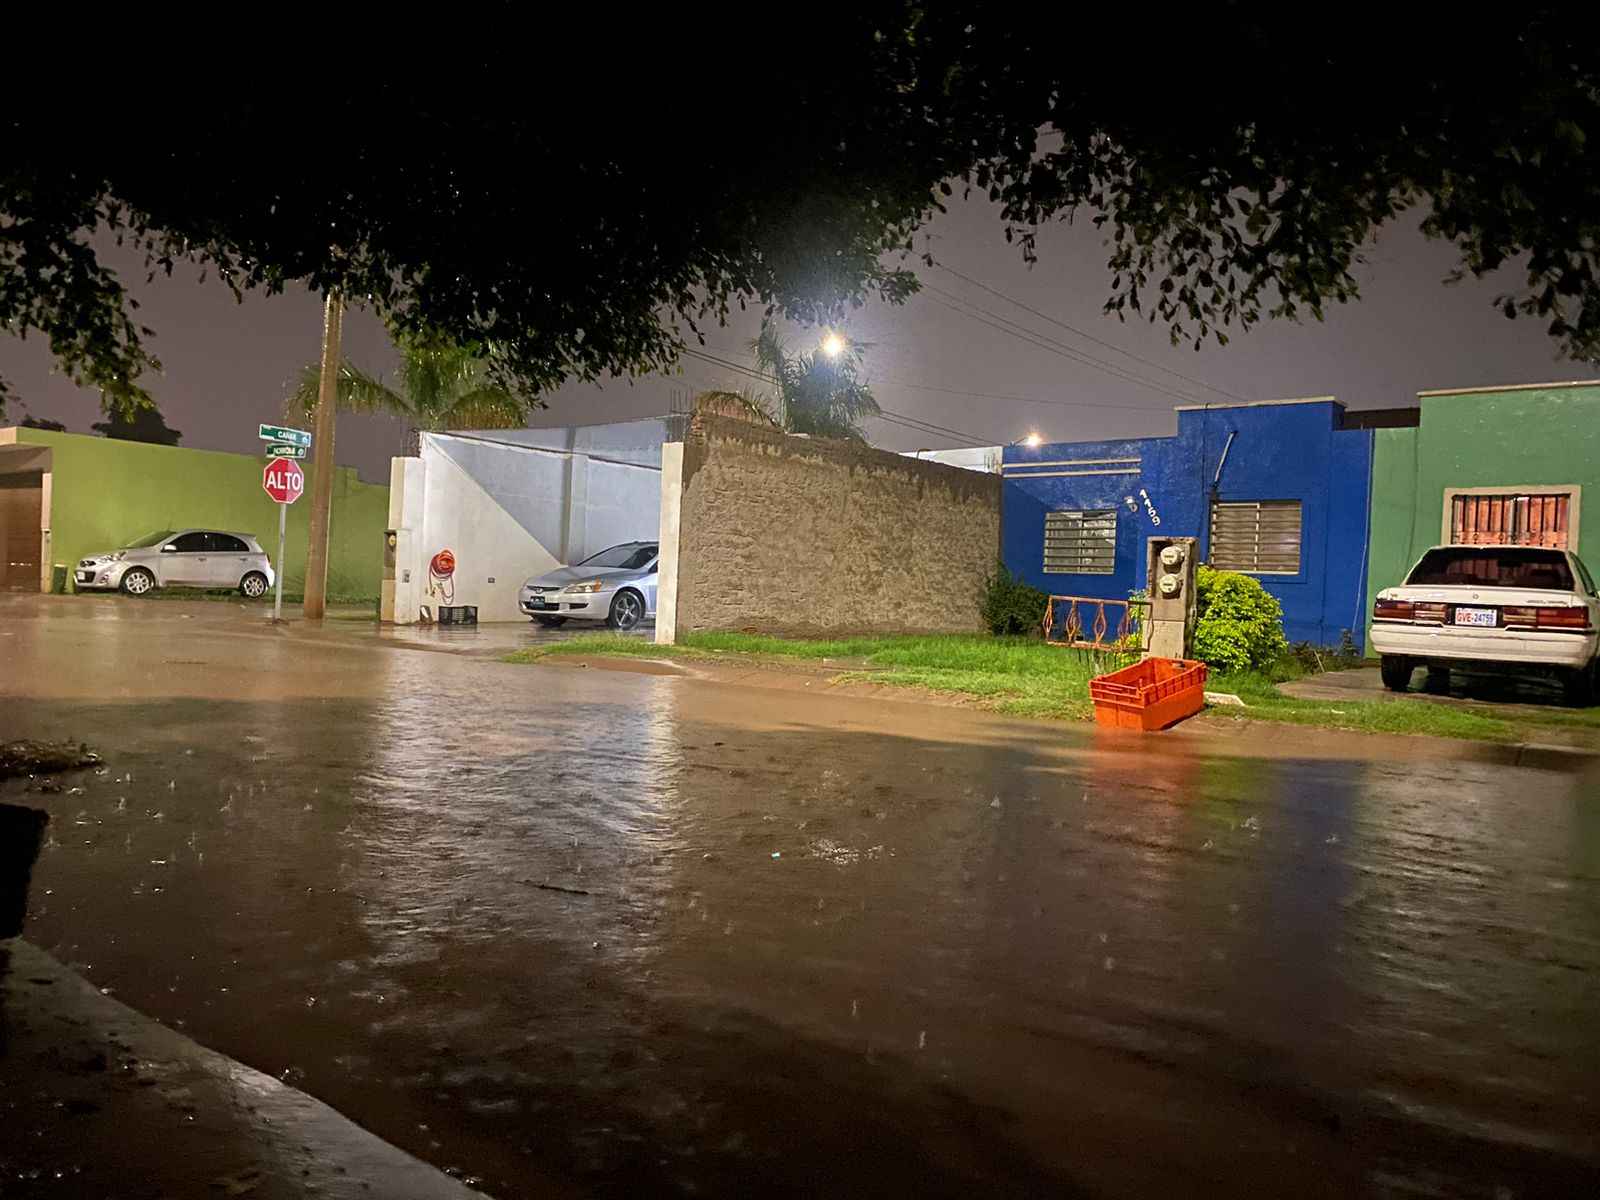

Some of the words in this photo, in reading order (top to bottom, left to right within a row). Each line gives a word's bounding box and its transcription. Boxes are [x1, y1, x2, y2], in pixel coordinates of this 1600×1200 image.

[265, 470, 301, 491] ALTO
[1139, 488, 1161, 526] 1159
[1456, 612, 1494, 623] GVE-24759
